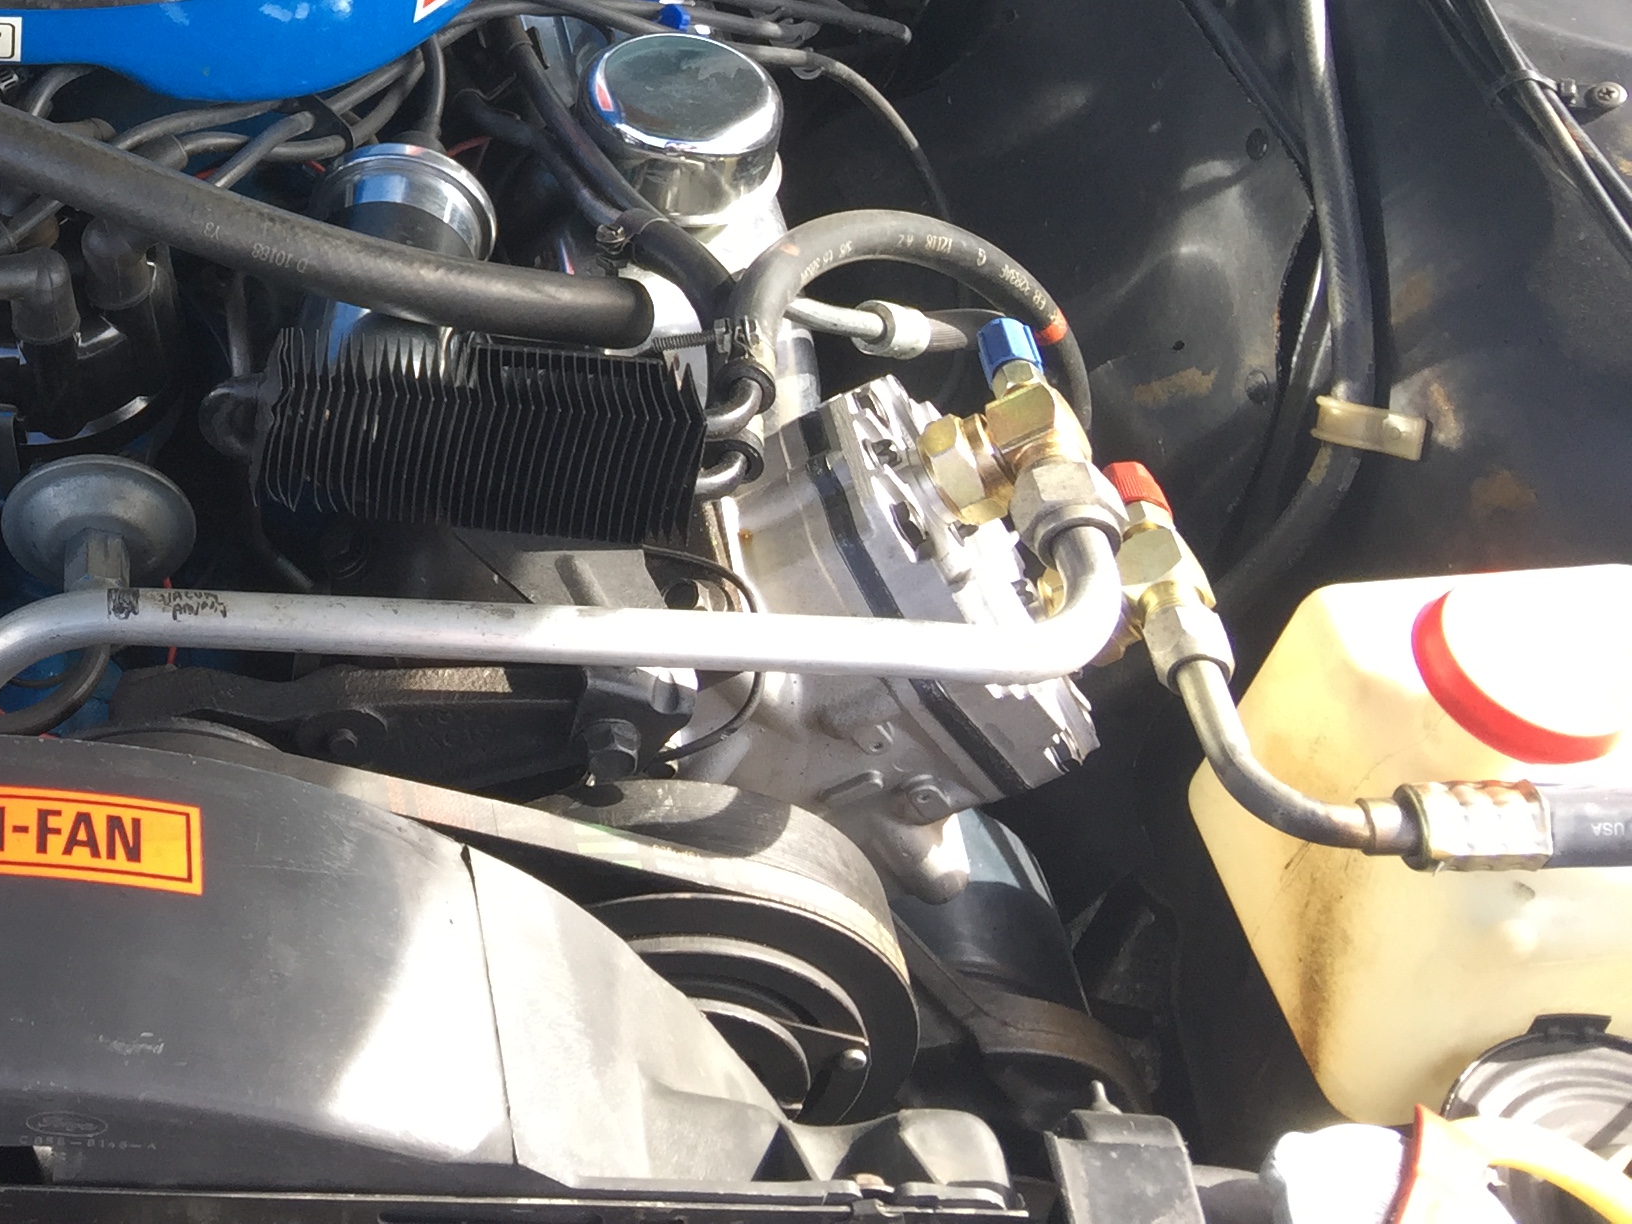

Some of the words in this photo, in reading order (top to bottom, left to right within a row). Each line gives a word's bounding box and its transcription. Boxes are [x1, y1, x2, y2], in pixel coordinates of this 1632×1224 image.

[250, 242, 294, 269] 10188
[296, 257, 309, 274] D
[1590, 821, 1626, 838] USA
